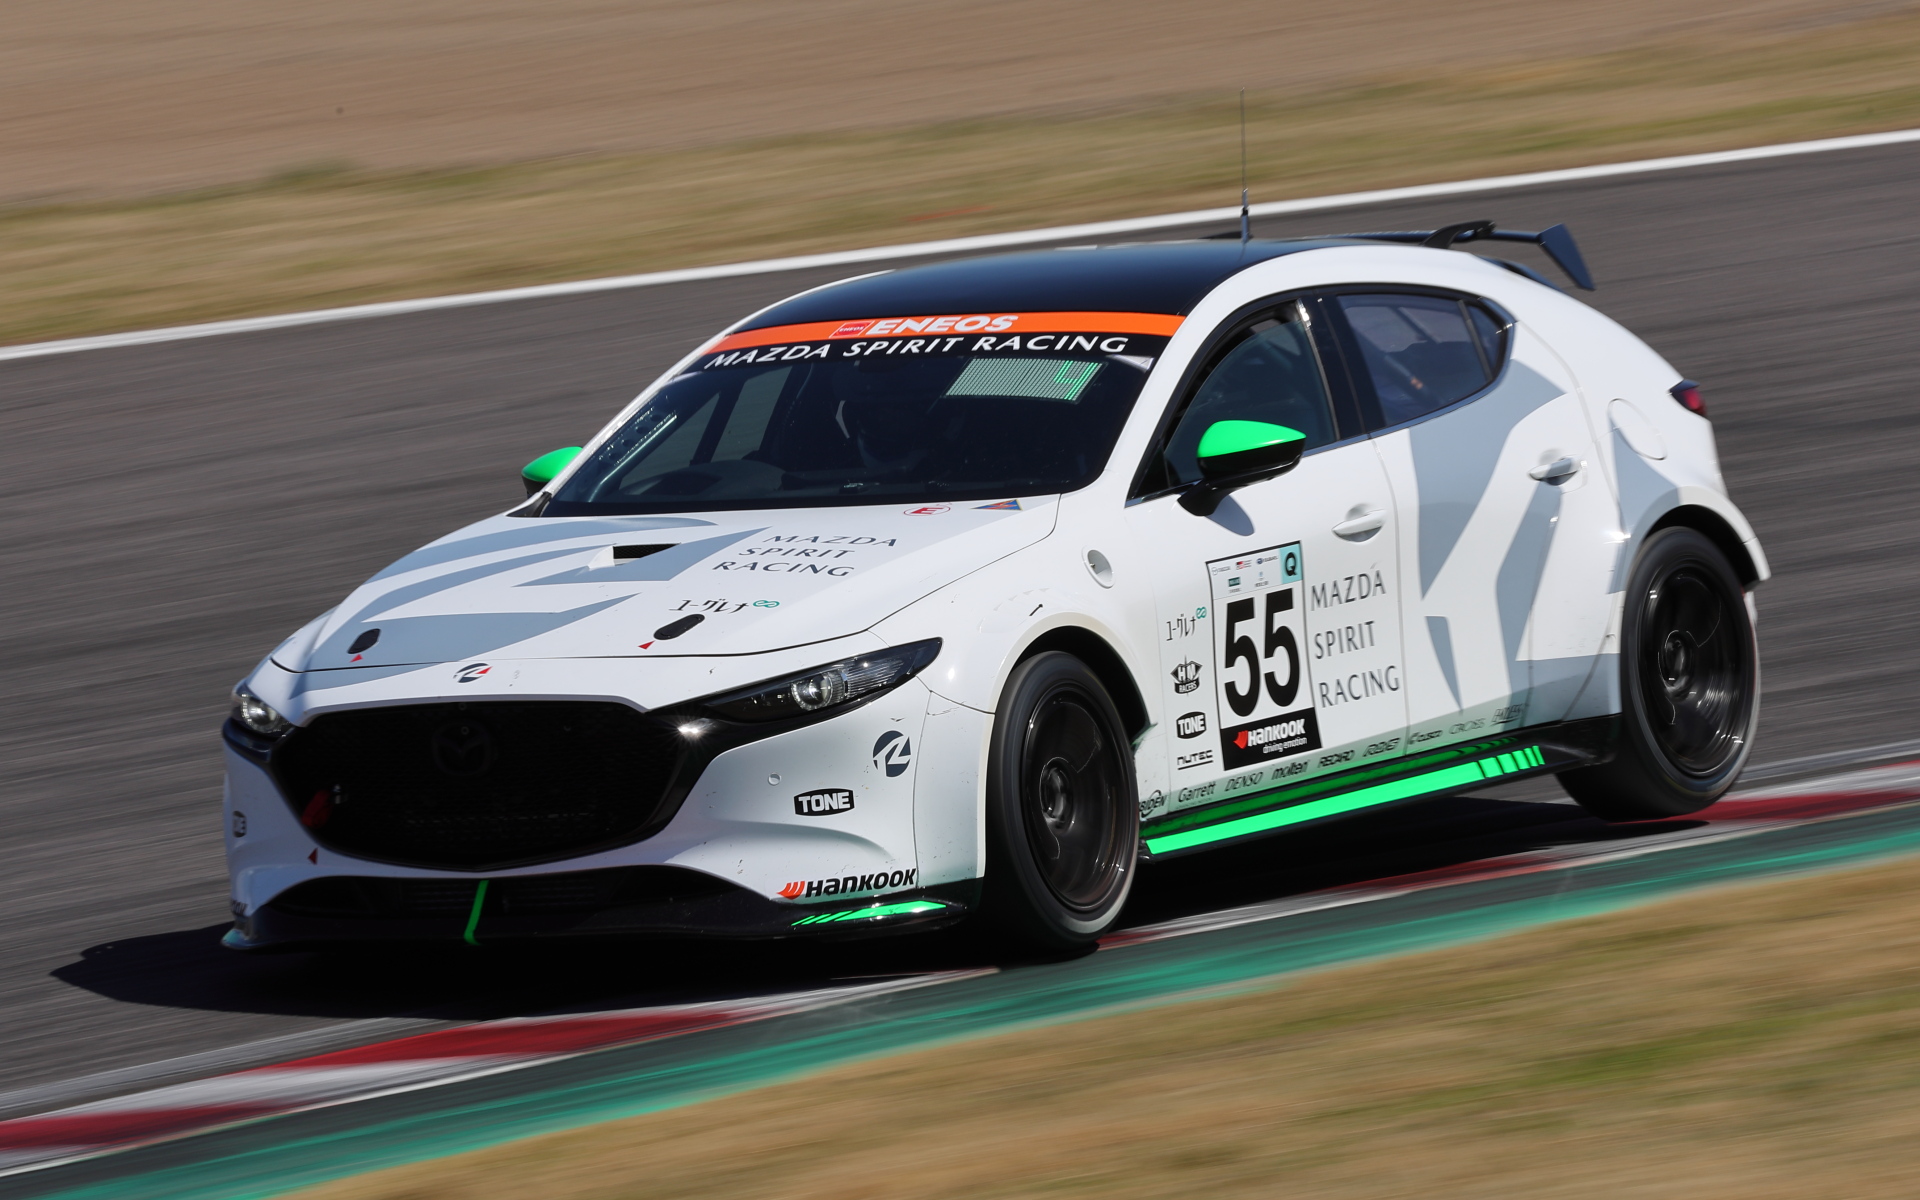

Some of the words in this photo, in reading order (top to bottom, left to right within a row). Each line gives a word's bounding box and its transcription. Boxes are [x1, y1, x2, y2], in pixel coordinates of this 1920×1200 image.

[865, 315, 1018, 335] ENEOS
[704, 343, 830, 369] MAZDA
[843, 337, 964, 357] SPIRIT
[972, 335, 1129, 353] RACING
[763, 535, 897, 547] MAZDA
[738, 547, 855, 558] SPIRIT
[712, 561, 854, 577] RACING
[1285, 552, 1297, 576] Q
[1311, 568, 1386, 611] MAZDA
[1314, 621, 1375, 659] SPIRIT
[1224, 588, 1301, 717] 55
[1319, 665, 1400, 708] RACING
[1177, 714, 1205, 736] TONE
[1272, 759, 1309, 781] molten
[1178, 781, 1216, 803] Garrett
[1224, 771, 1264, 792] DENSO
[798, 792, 851, 813] TONE
[805, 868, 917, 898] HANKOOK
